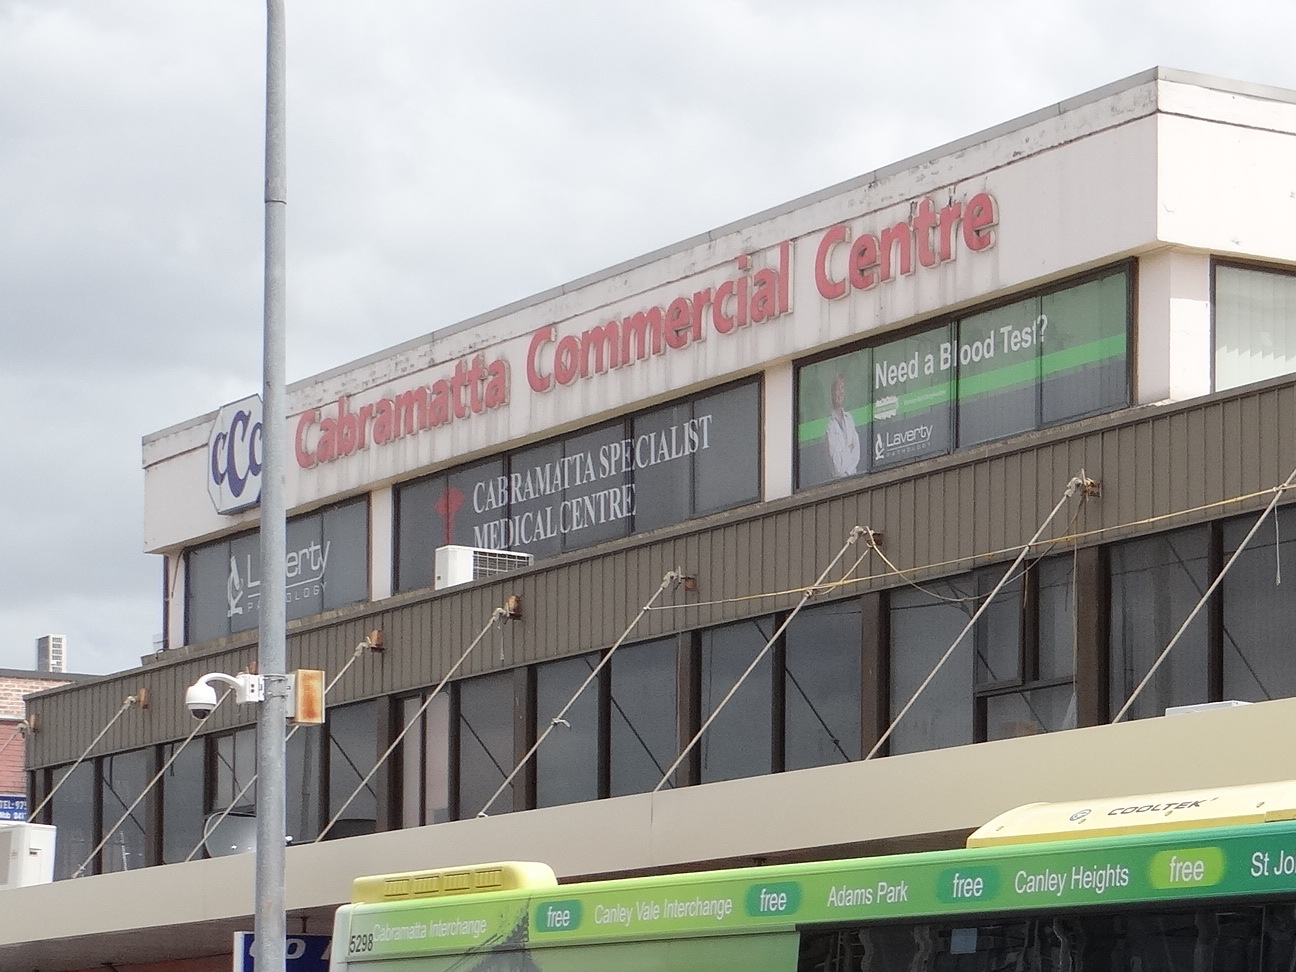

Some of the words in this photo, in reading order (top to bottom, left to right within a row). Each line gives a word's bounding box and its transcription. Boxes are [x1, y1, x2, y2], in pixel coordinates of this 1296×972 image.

[294, 353, 510, 469] Cabramatta
[526, 240, 795, 393] Commercial
[814, 191, 999, 301] Centre
[875, 353, 918, 389] Need
[924, 352, 935, 376] a
[940, 330, 994, 371] Blood
[1000, 314, 1048, 353] Test?
[886, 424, 934, 447] Laverty
[473, 449, 597, 514] CABRAMATTA
[599, 414, 713, 479] SPECIALIST
[473, 505, 557, 550] MEDICAL
[559, 483, 637, 534] CENTRE
[247, 540, 331, 588] Lerty
[1107, 799, 1206, 816] COOLTEK
[1169, 856, 1204, 883] free
[1250, 851, 1270, 877] St
[827, 885, 873, 907] Adams
[877, 880, 908, 903] Park
[952, 872, 983, 898] free
[1015, 869, 1067, 896] Canley
[1070, 864, 1130, 894] Heights
[594, 904, 633, 927] Canley
[635, 901, 660, 921] Vale
[663, 897, 732, 920] Interchange
[759, 888, 787, 912] free
[373, 921, 428, 942] Cabramatta
[430, 916, 488, 938] Interchange
[546, 906, 571, 928] free
[350, 933, 374, 954] 5298
